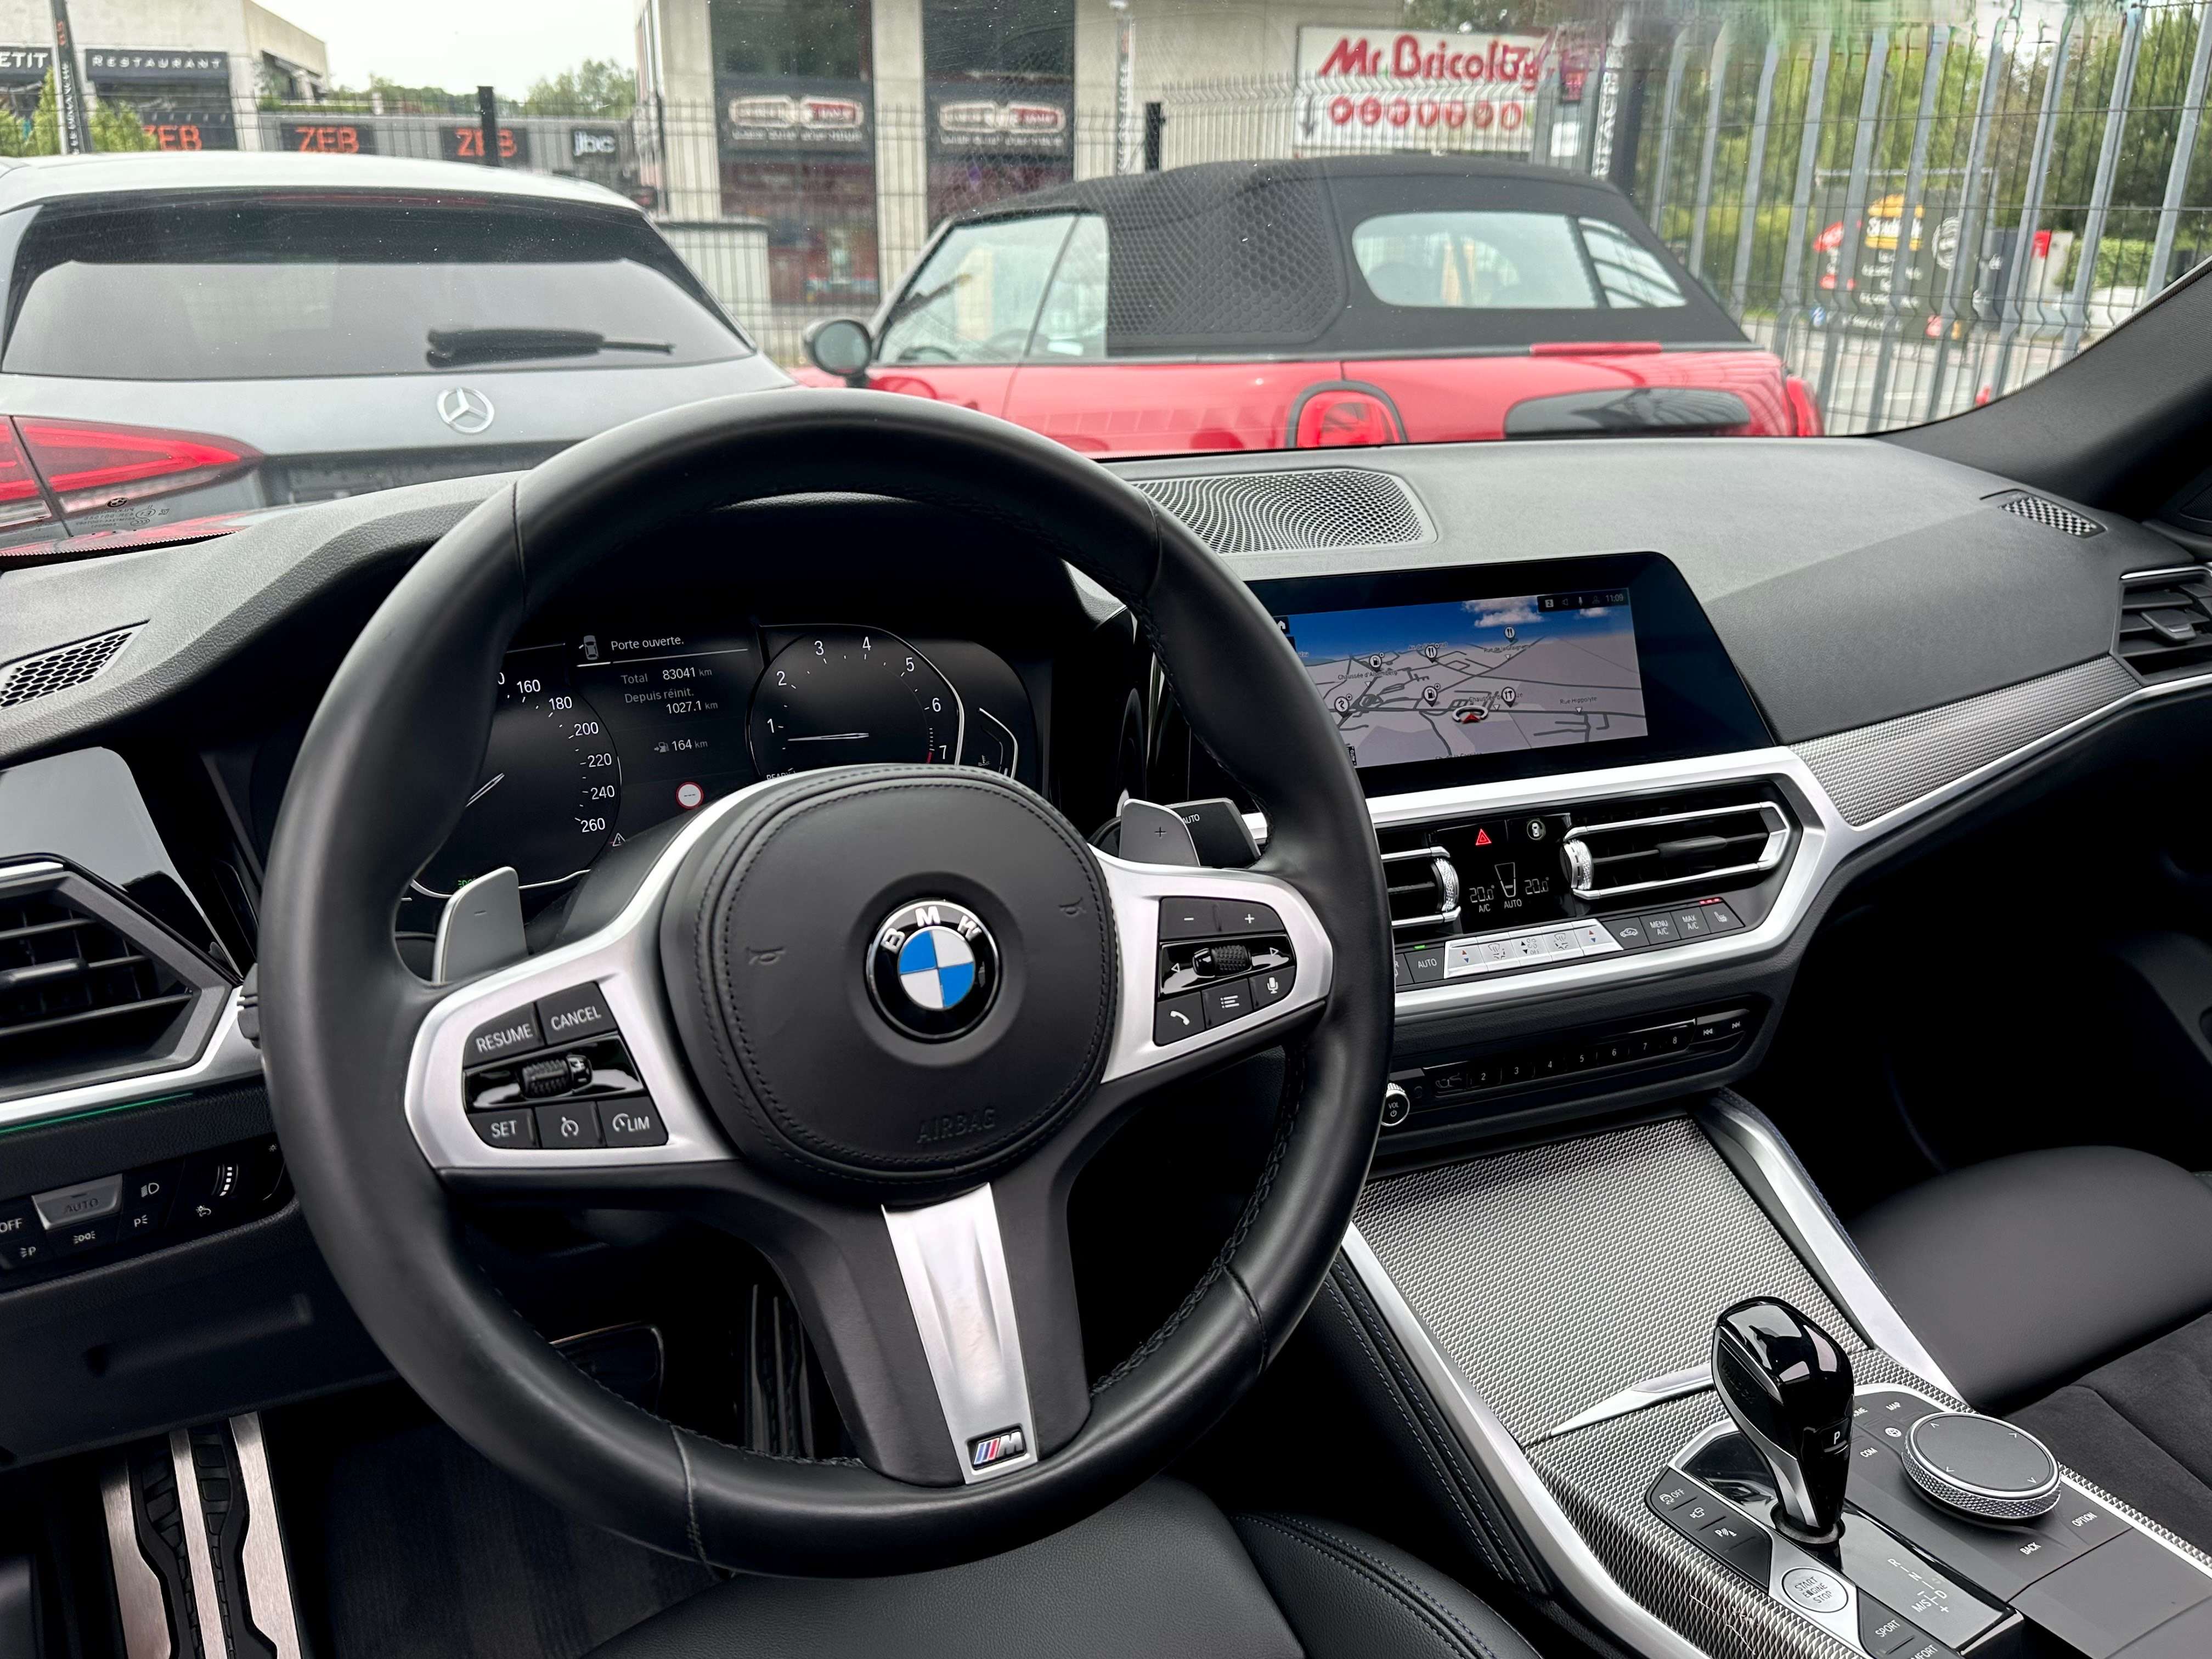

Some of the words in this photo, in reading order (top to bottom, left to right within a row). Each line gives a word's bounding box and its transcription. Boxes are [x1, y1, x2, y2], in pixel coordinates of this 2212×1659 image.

[295, 126, 359, 154] ZEB
[574, 132, 616, 157] jbc
[611, 639, 639, 651] Porte
[642, 636, 684, 648] ouverte.
[814, 641, 824, 656] 3
[862, 636, 871, 650] 4
[906, 657, 915, 672] 5
[620, 673, 648, 685] Total
[663, 667, 696, 680] 83041
[699, 668, 712, 676] km
[777, 671, 786, 685] 2
[517, 679, 540, 693] 160
[625, 691, 662, 704] Depuis
[664, 687, 694, 699] réinit.
[549, 696, 572, 711] 180
[666, 701, 702, 714] 1027.1
[705, 701, 718, 709] km
[933, 698, 941, 712] 6
[574, 722, 599, 736] 200
[768, 719, 774, 732] 1
[672, 740, 692, 751] 164
[695, 740, 708, 748] km
[939, 746, 947, 759] 7
[588, 753, 612, 768] 220
[591, 785, 615, 800] 240
[580, 818, 606, 832] 260
[1182, 814, 1200, 824] AUTO
[1479, 904, 1491, 912] A/C
[1504, 899, 1522, 909] AUTO
[881, 906, 981, 953] BMW
[1650, 920, 1668, 928] MENU
[1418, 958, 1437, 968] AUTO
[551, 1006, 602, 1031] CANCEL
[476, 1024, 533, 1053] RESUME
[491, 1121, 517, 1138] SET
[627, 1116, 651, 1132] LIM
[917, 1108, 996, 1144] AIRBAG
[66, 1198, 99, 1212] AUTO
[0, 1217, 22, 1232] OFF
[1853, 1407, 1868, 1417] OME
[1886, 1402, 1900, 1410] MAP
[1834, 1431, 1840, 1444] P
[1860, 1447, 1878, 1457] COM
[1671, 1488, 1685, 1498] OFF
[2072, 1512, 2098, 1526] OPTION
[2020, 1542, 2041, 1555] BACK
[1888, 1559, 1901, 1567] R
[1795, 1576, 1818, 1591] START
[1908, 1572, 1922, 1581] N
[1802, 1583, 1827, 1598] ENGINE
[1813, 1591, 1832, 1603] STOP
[1934, 1590, 1947, 1599] D
[1911, 1599, 1932, 1612] M/S
[1875, 1620, 1900, 1637] SPORT
[1911, 1644, 1938, 1659] MFORT
